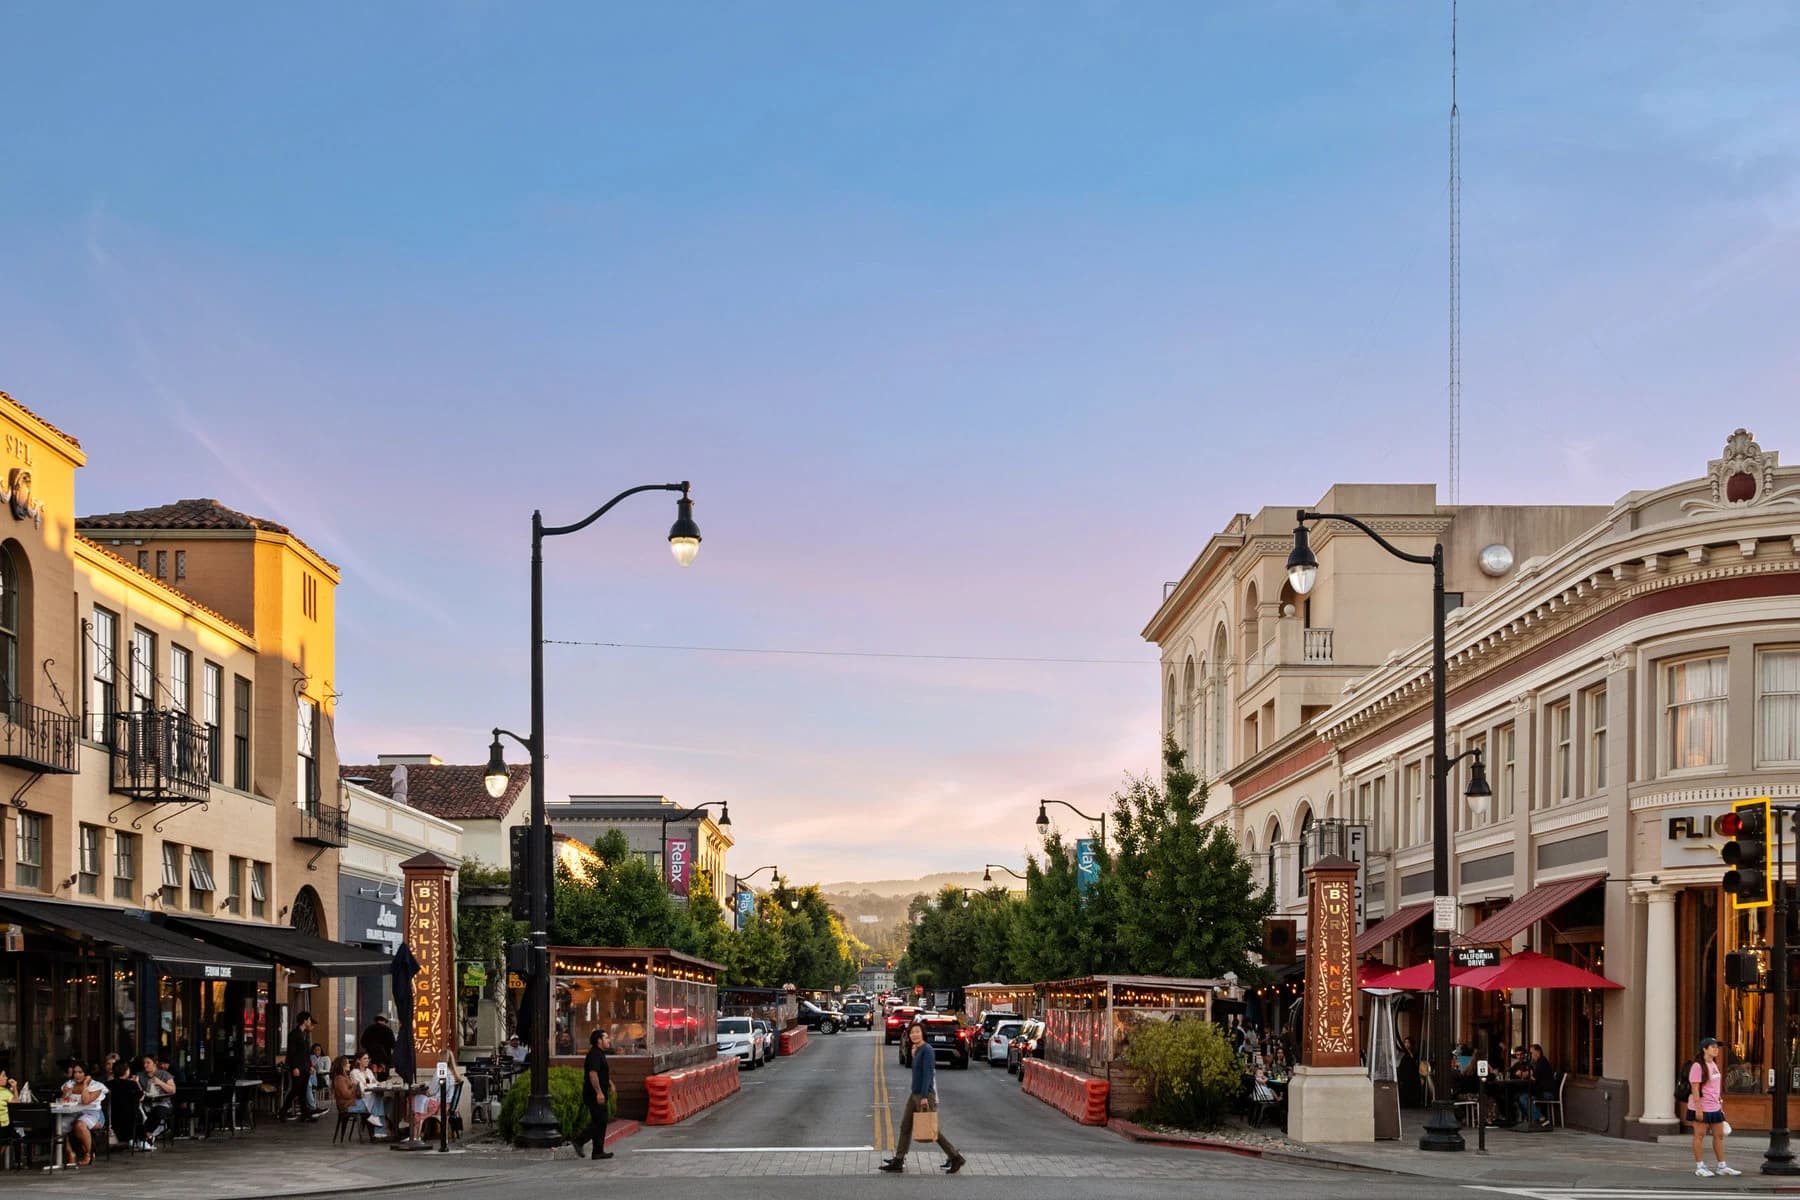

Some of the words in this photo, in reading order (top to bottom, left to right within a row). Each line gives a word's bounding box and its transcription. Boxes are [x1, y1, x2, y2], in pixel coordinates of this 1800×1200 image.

[1668, 811, 1800, 840] FLIT
[672, 841, 687, 883] Relax
[738, 893, 752, 913] Play
[417, 887, 431, 1038] BURLINGAME
[1329, 889, 1341, 1037] BURLINGAME
[1458, 952, 1494, 961] CALIFORNIA
